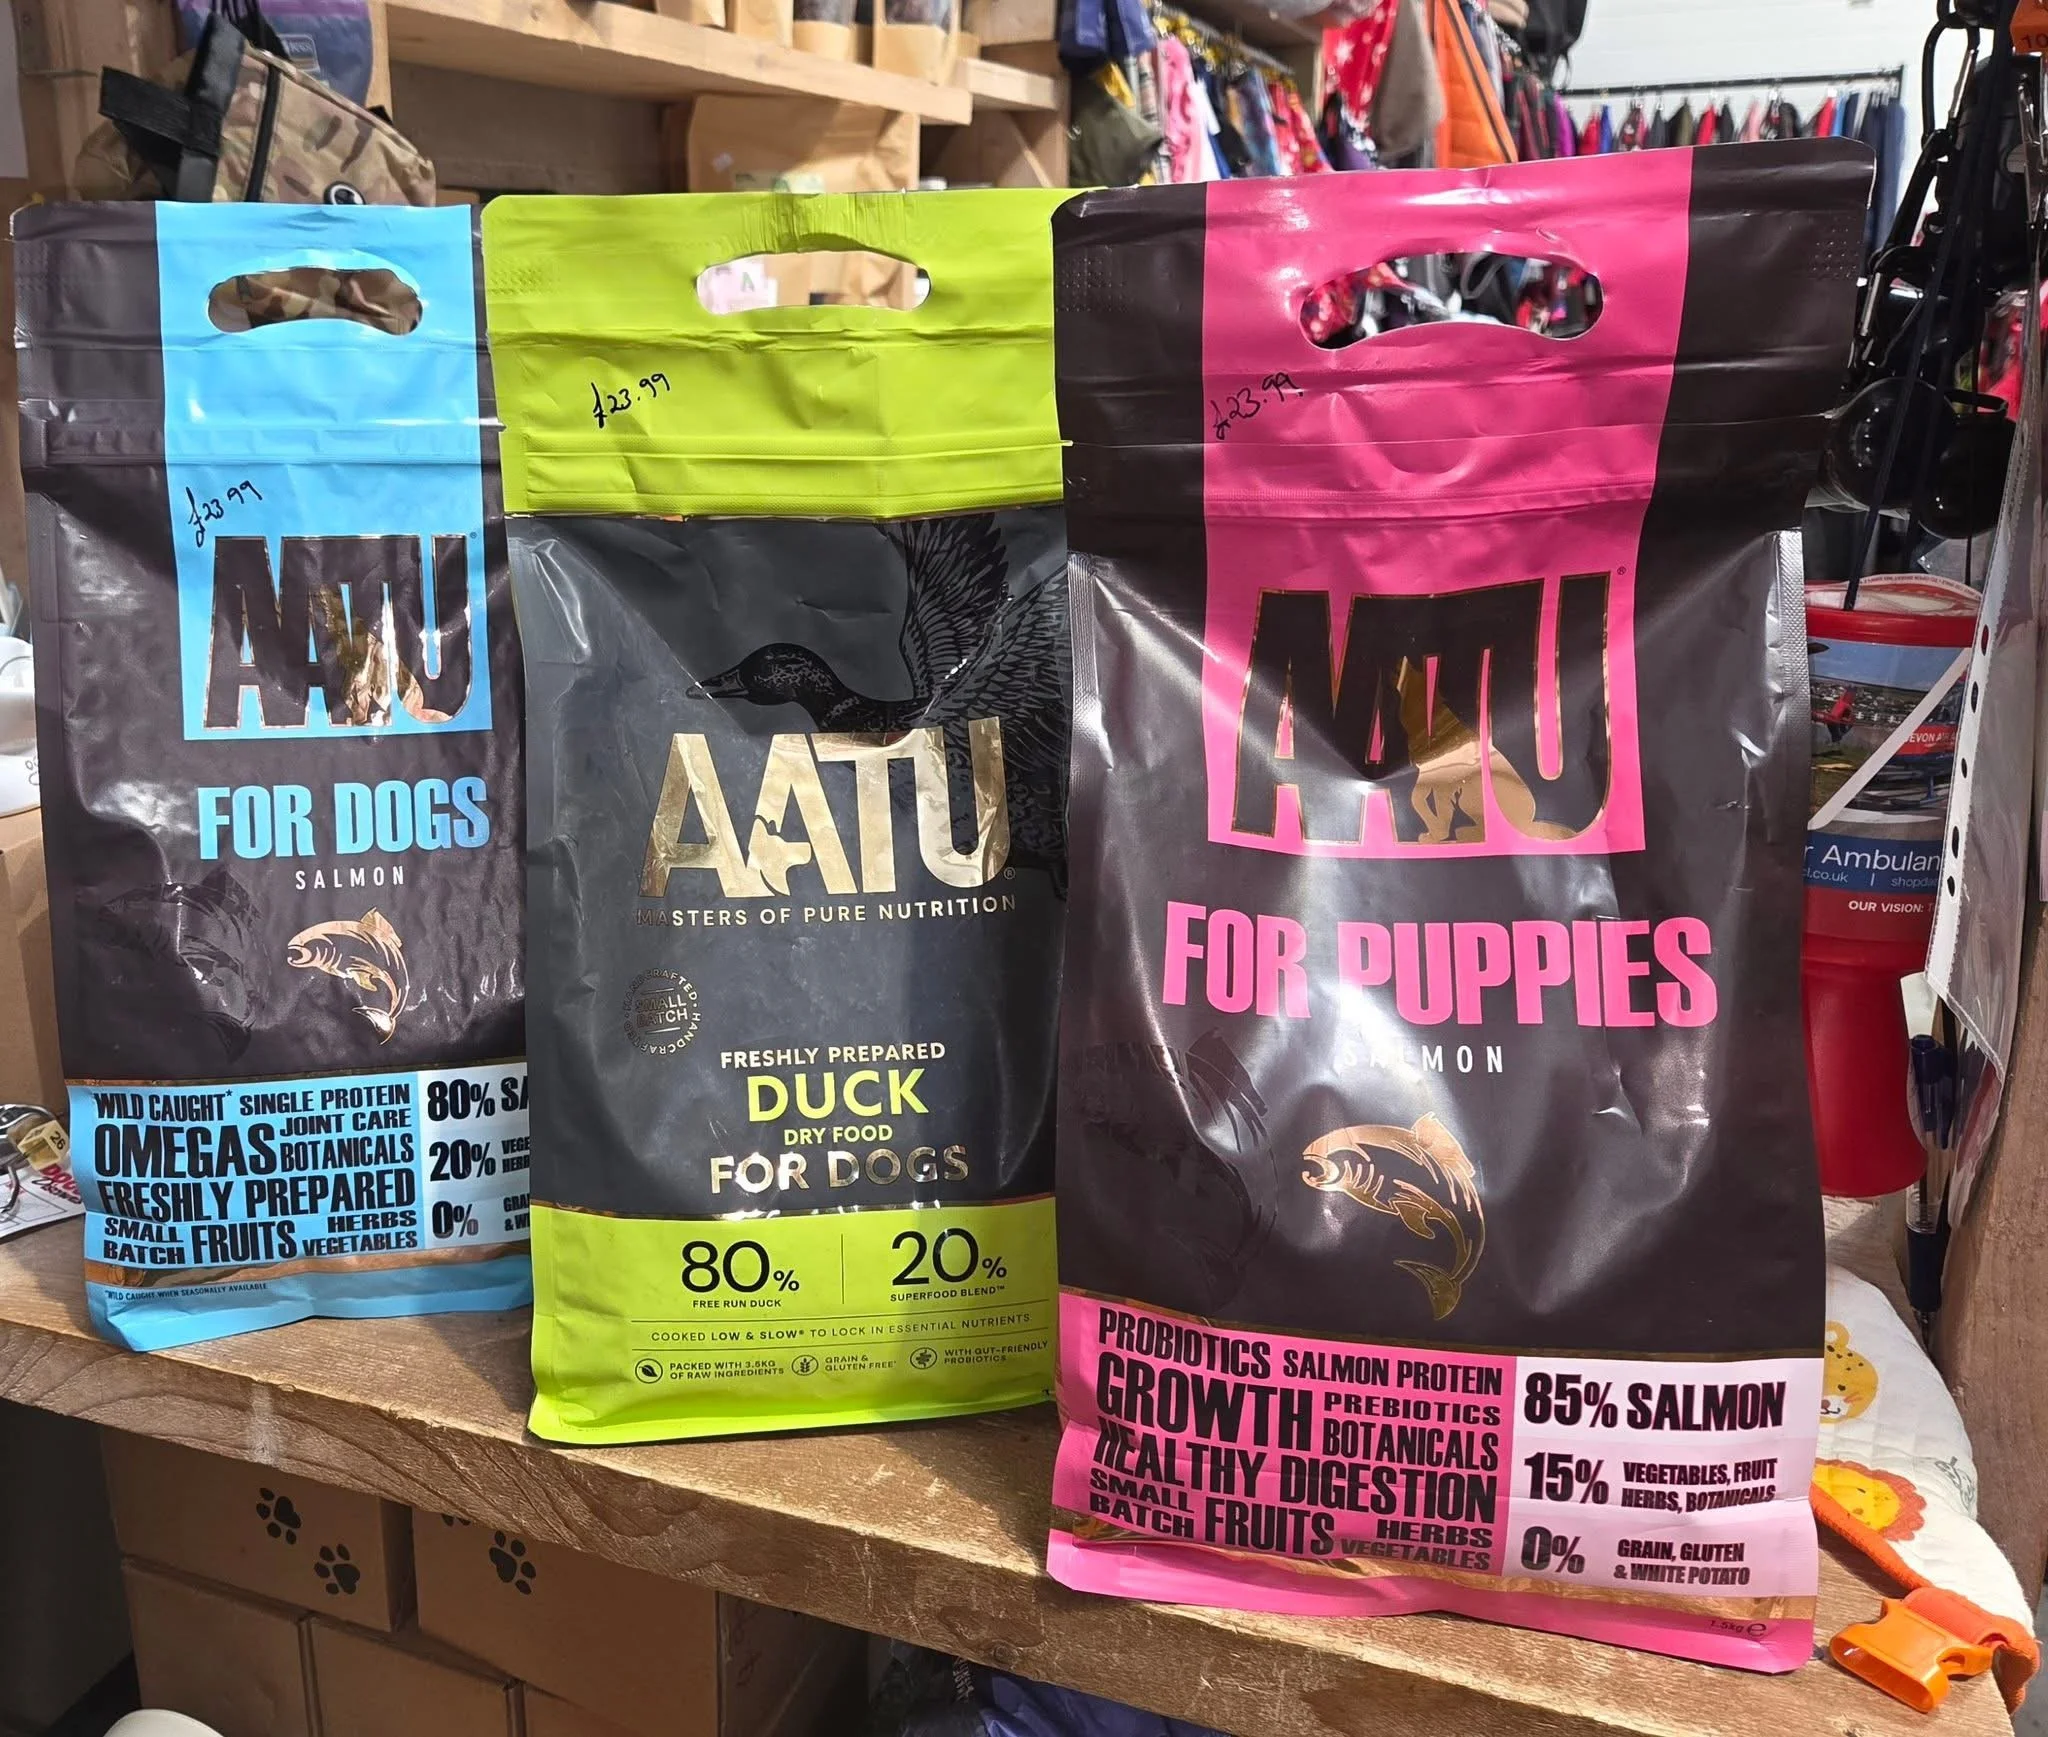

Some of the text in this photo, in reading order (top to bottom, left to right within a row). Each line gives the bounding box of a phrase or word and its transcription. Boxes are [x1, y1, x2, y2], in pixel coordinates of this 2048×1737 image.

[1907, 732, 1936, 743] EVON
[198, 776, 490, 860] FOR DOGS
[1821, 844, 1941, 872] Ambulan
[295, 865, 405, 890] SALMON
[1803, 867, 1849, 883] l.co.uk
[636, 895, 1016, 927] MASTERS OF PURE NUTRITION
[1848, 900, 1877, 912] OUR
[1880, 901, 1924, 913] VISION:
[1161, 900, 1718, 1029] FOR PUPPIES
[635, 994, 687, 1012] SMALL
[636, 1007, 688, 1028] BATCH
[720, 1042, 946, 1069] FRESHLY PREPARED
[1342, 1042, 1503, 1073] SMON
[93, 1092, 144, 1120] WILD
[240, 1090, 314, 1116] SINGLE
[321, 1083, 410, 1111] PROTEIN
[427, 1079, 496, 1122] 80%
[747, 1068, 929, 1122] DUCK
[280, 1108, 412, 1138] JOINT CARE
[784, 1125, 893, 1146] DRY FOOD
[95, 1122, 277, 1179] OMEGAS
[280, 1132, 414, 1174] BOTANICALS
[429, 1139, 497, 1182] 20%
[709, 1144, 969, 1194] FOR DOGS
[97, 1180, 234, 1223] FRESHLY
[245, 1167, 416, 1219] PREPARED
[104, 1217, 184, 1243] SMALL
[327, 1209, 417, 1233] HERBS
[432, 1200, 479, 1239] 0%
[505, 1218, 514, 1231] &
[103, 1239, 185, 1265] BATCH
[191, 1219, 298, 1265] FRUITS
[302, 1230, 418, 1257] VEGETABLES
[681, 1227, 1008, 1293] 80% 20%
[126, 1291, 155, 1301] CAUGHT
[158, 1289, 179, 1299] WHEN
[181, 1285, 227, 1298] SEASONALLY
[229, 1282, 268, 1293] AVAILABLE
[693, 1299, 782, 1308] FREE RUN DUCK
[890, 1290, 958, 1302] SUPERFOOD
[651, 1332, 706, 1342] COOKED
[711, 1331, 740, 1341] LOW
[746, 1331, 754, 1340] &
[810, 1328, 827, 1338] TO
[832, 1326, 866, 1337] LOCK
[871, 1326, 884, 1335] IN
[889, 1321, 956, 1334] ESSENTIAL
[961, 1313, 1031, 1329] NUTRIENTS
[824, 1353, 869, 1364] GRAIN &
[944, 1340, 1049, 1357] WITH GUT-FRIENDLY
[944, 1354, 1007, 1365] PROBIOTICS
[1098, 1306, 1503, 1396] PROBIOTICS SALMON PROTEIN
[669, 1362, 712, 1371] PACKED
[714, 1361, 743, 1370] WITH
[670, 1367, 785, 1380] OF RAW INGREDIENTS
[824, 1362, 866, 1372] GLUTEN
[1097, 1351, 1313, 1452] GROWTH
[1324, 1391, 1501, 1426] PREBIOTICS
[1523, 1372, 1787, 1432] 85% SALMON
[1322, 1417, 1499, 1472] BOTANICALS
[1093, 1415, 1498, 1524] HEALTHY DIGESTION
[1524, 1452, 1609, 1505] 15%
[1622, 1457, 1778, 1486] VEGETABLES, FRUIT
[1090, 1467, 1195, 1514] SMALL
[1621, 1484, 1777, 1514] HERBS, BOTANICALS
[1090, 1491, 1195, 1539] BATCH
[1204, 1495, 1335, 1556] FRUITS
[1376, 1518, 1493, 1549] HERBS
[1340, 1537, 1491, 1571] VEGETABLES
[1520, 1526, 1586, 1574] 0%
[1617, 1538, 1745, 1562] GRAIN, GLUTEN
[1613, 1564, 1751, 1586] & WHITE POTATO
